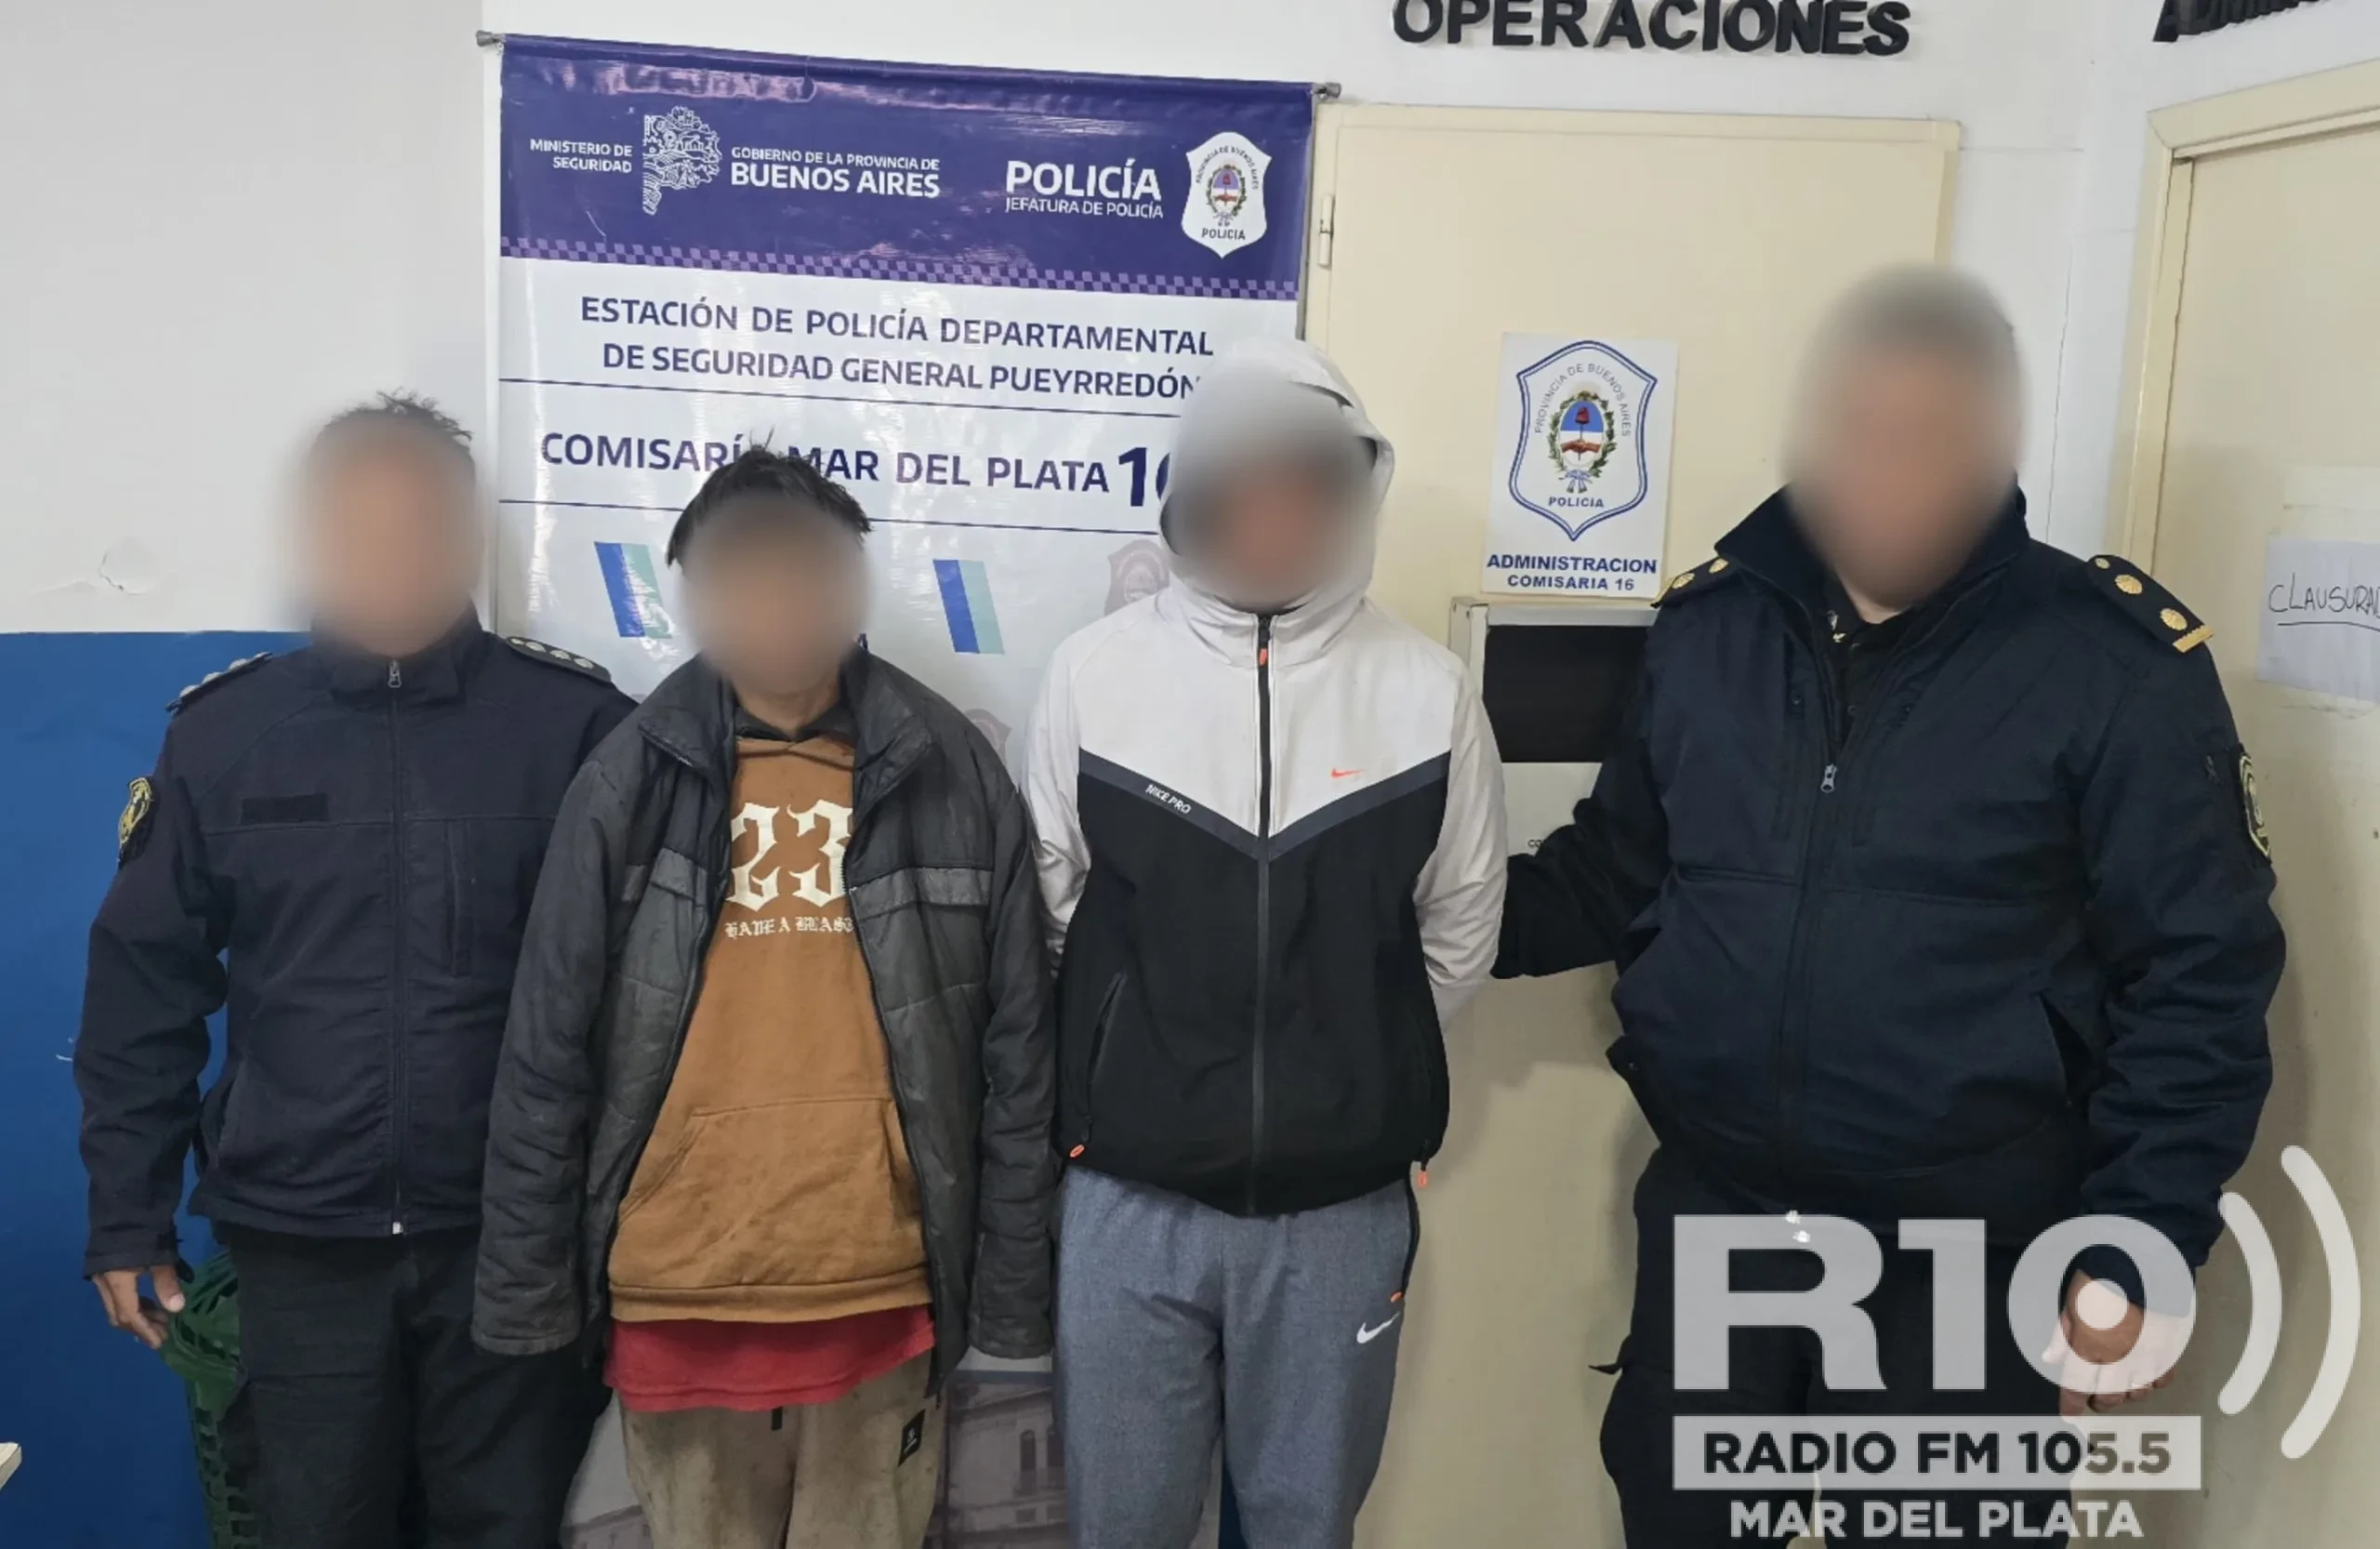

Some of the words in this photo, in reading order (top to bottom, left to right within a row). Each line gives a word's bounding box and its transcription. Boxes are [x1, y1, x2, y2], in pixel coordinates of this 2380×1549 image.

[1392, 0, 1911, 56] OPERACIONES
[530, 139, 611, 155] MINISTERIO
[614, 144, 632, 157] DE
[731, 146, 802, 162] GOBIERNO
[804, 151, 823, 164] DE
[826, 152, 843, 165] LA
[846, 154, 919, 170] PROVINCIA
[920, 158, 940, 170] DE
[553, 156, 632, 173] SEGURIDAD
[731, 162, 850, 192] BUENOS
[856, 170, 941, 198] AIRES
[1006, 157, 1162, 201] POLICÍA
[1005, 197, 1079, 214] JEFATURA
[1082, 201, 1104, 216] DE
[1106, 200, 1164, 218] POLICÍA
[1201, 228, 1246, 241] POLICIA
[581, 297, 738, 331] ESTACIÓN
[751, 306, 793, 333] DE
[806, 308, 929, 342] POLICÍA
[940, 317, 1214, 356] DEPARTAMENTAL
[603, 342, 645, 369] DE
[652, 346, 834, 380] SEGURIDAD
[841, 357, 983, 390] GENERAL
[1534, 375, 1568, 433] PROVINCIA
[1567, 363, 1584, 376] DE
[1588, 363, 1626, 402] BUENOS
[1619, 403, 1632, 437] AIRES
[541, 432, 744, 472] COMISARÍ
[896, 452, 971, 486] DEL
[987, 457, 1110, 493] PLATA
[1118, 446, 1170, 507] 1
[1548, 496, 1604, 508] POLICIA
[1487, 554, 1658, 573] ADMINISTRACION
[1507, 575, 1608, 590] COMISARIA
[1615, 578, 1634, 590] 16
[1145, 784, 1170, 802] NIKE
[1168, 796, 1191, 814] PRO
[725, 799, 853, 912] 23
[778, 916, 790, 933] A
